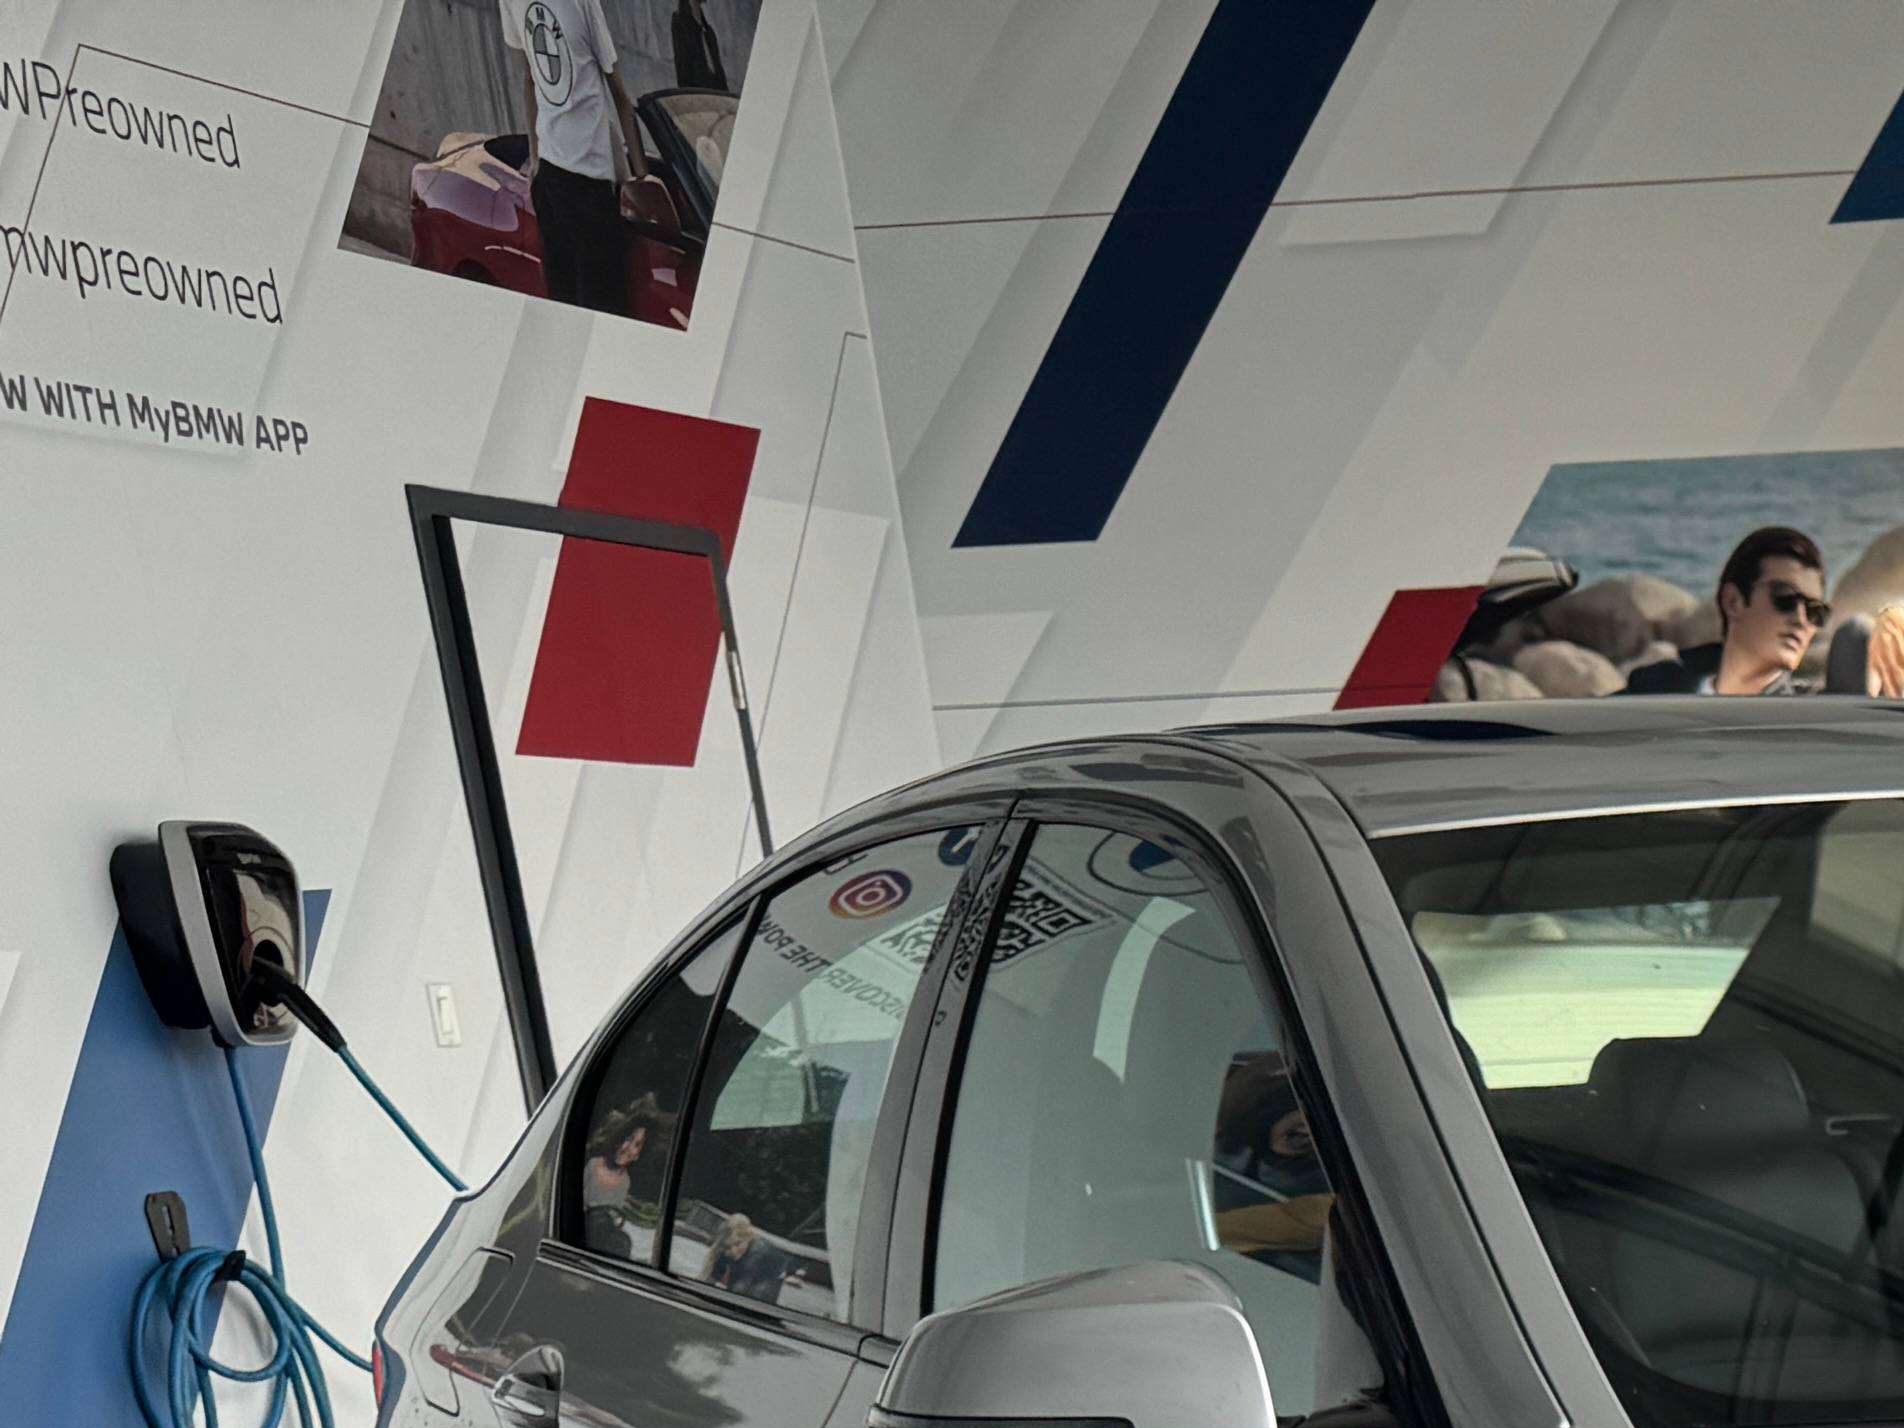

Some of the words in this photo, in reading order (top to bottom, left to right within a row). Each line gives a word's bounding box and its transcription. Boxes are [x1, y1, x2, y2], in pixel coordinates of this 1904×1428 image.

[34, 376, 121, 427] WITH
[126, 392, 244, 443] MyBMW
[256, 414, 308, 456] APP
